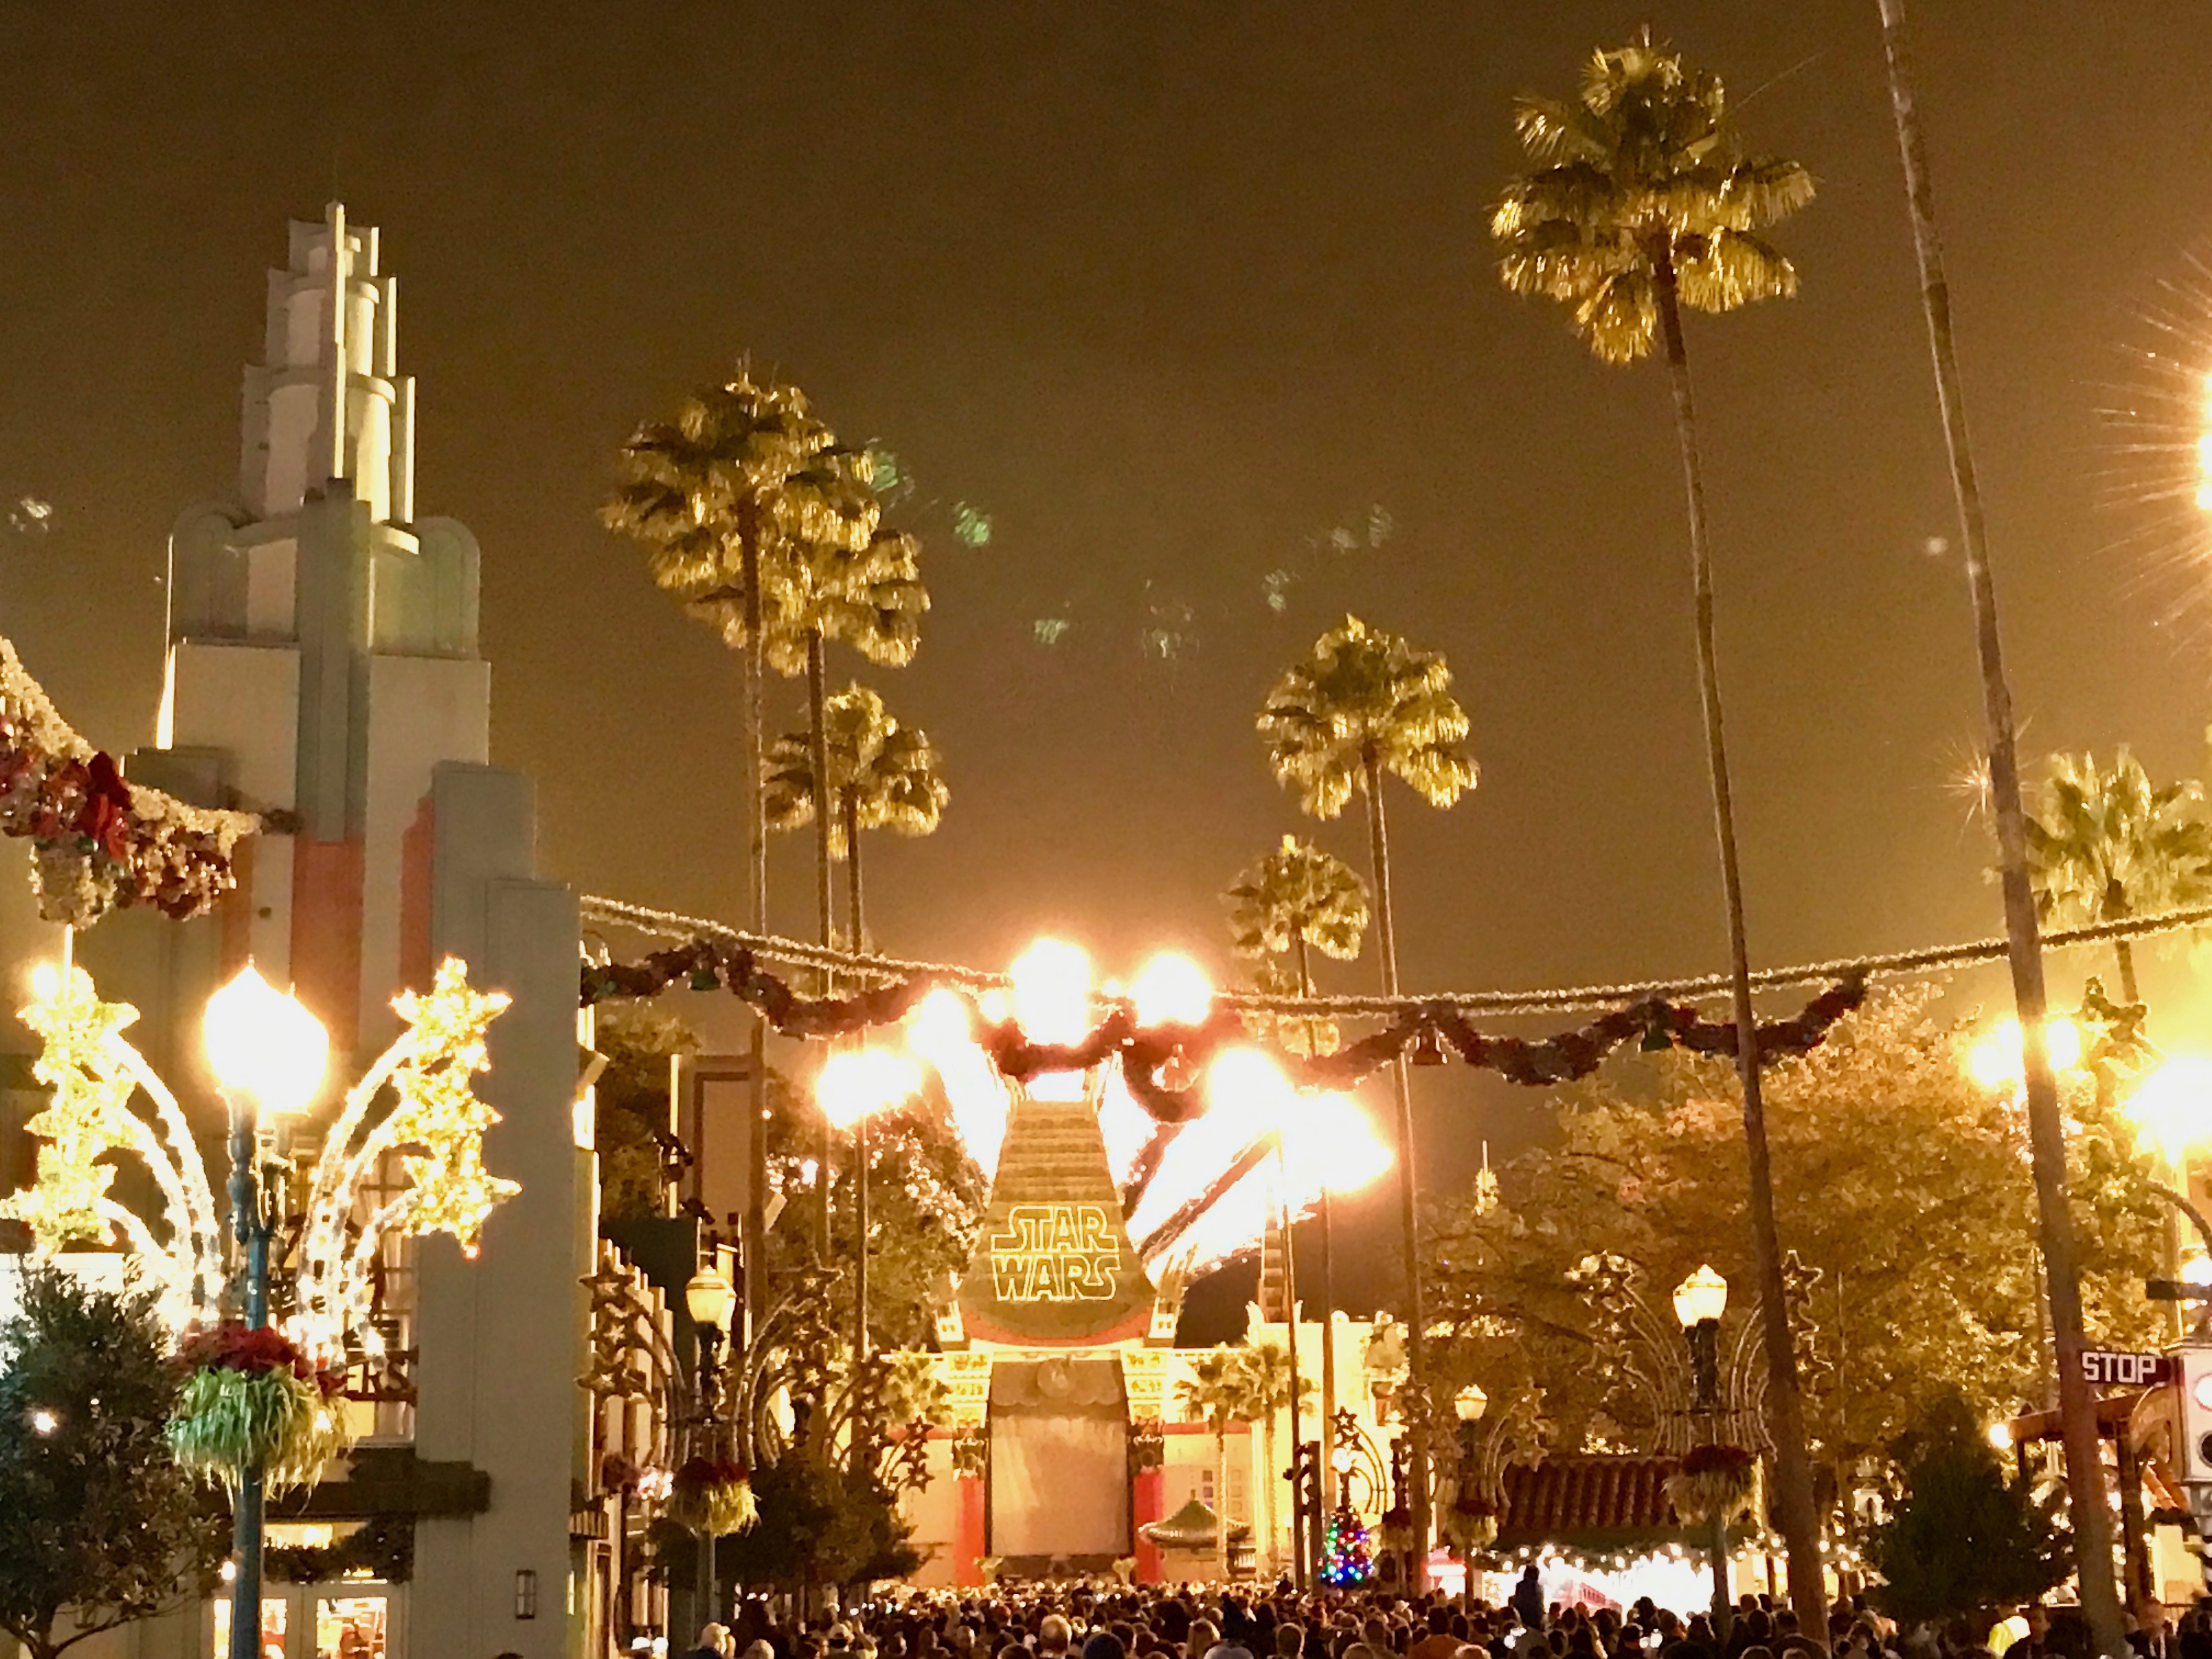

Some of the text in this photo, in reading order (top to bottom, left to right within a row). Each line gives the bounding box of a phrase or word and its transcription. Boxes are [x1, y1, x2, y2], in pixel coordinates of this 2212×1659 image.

[990, 1205, 1119, 1252] STAR
[990, 1254, 1121, 1301] WARS
[2082, 1351, 2157, 1384] STOP
